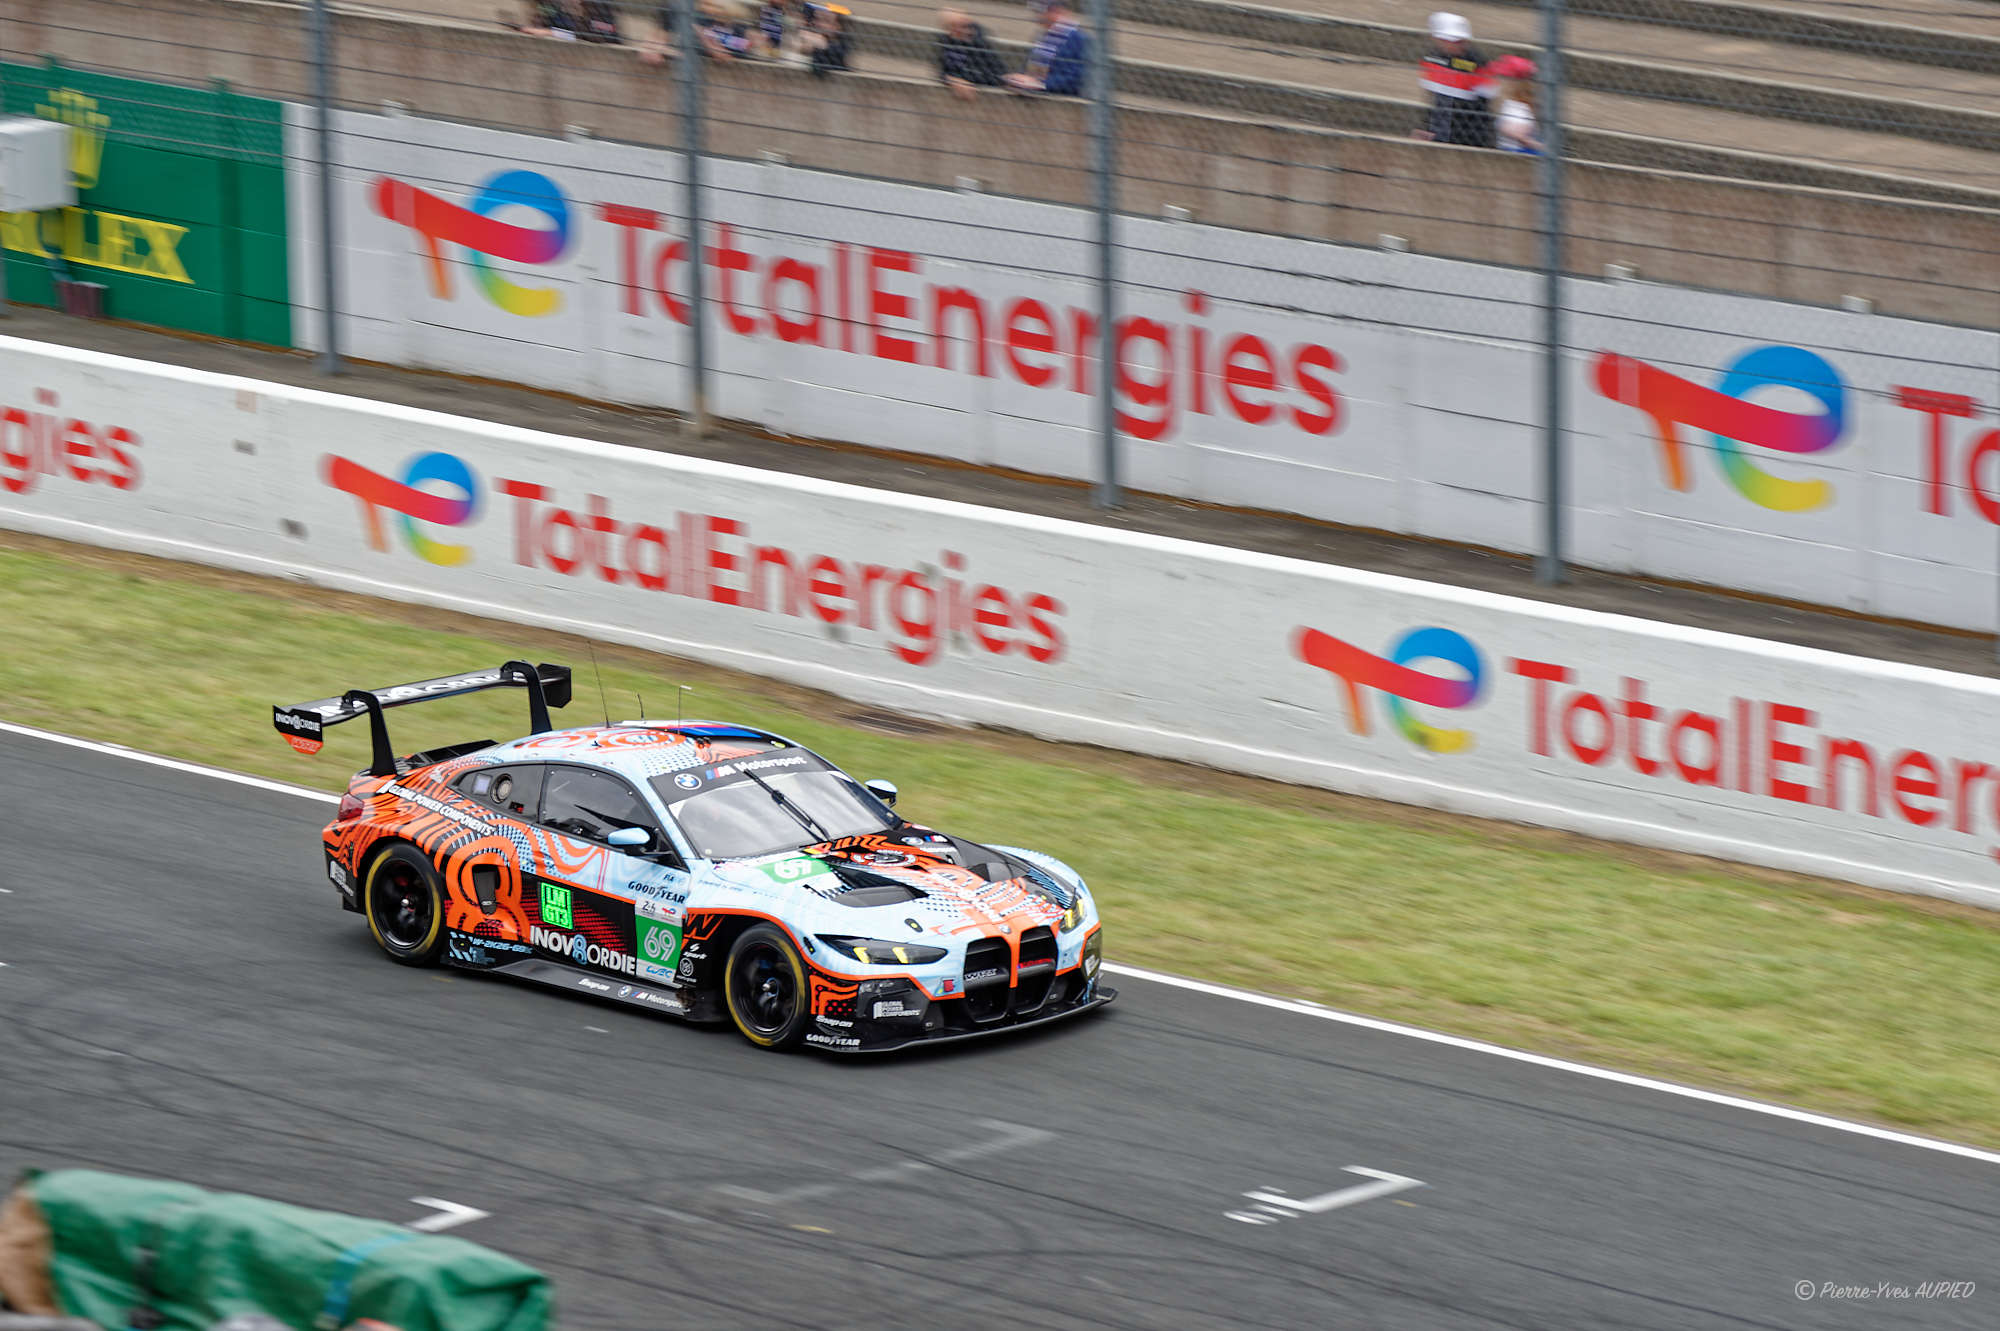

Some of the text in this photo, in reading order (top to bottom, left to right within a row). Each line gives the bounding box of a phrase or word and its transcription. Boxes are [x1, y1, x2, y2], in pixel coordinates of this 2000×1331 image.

[597, 200, 1347, 440] TotalEnergies
[494, 477, 1067, 666] TotalEnergies
[1505, 657, 2000, 866] TotalEner
[545, 905, 569, 926] GT3
[530, 925, 636, 975] INOV8ORDIE
[644, 926, 676, 961] 69
[816, 1014, 853, 1027] Snap-on
